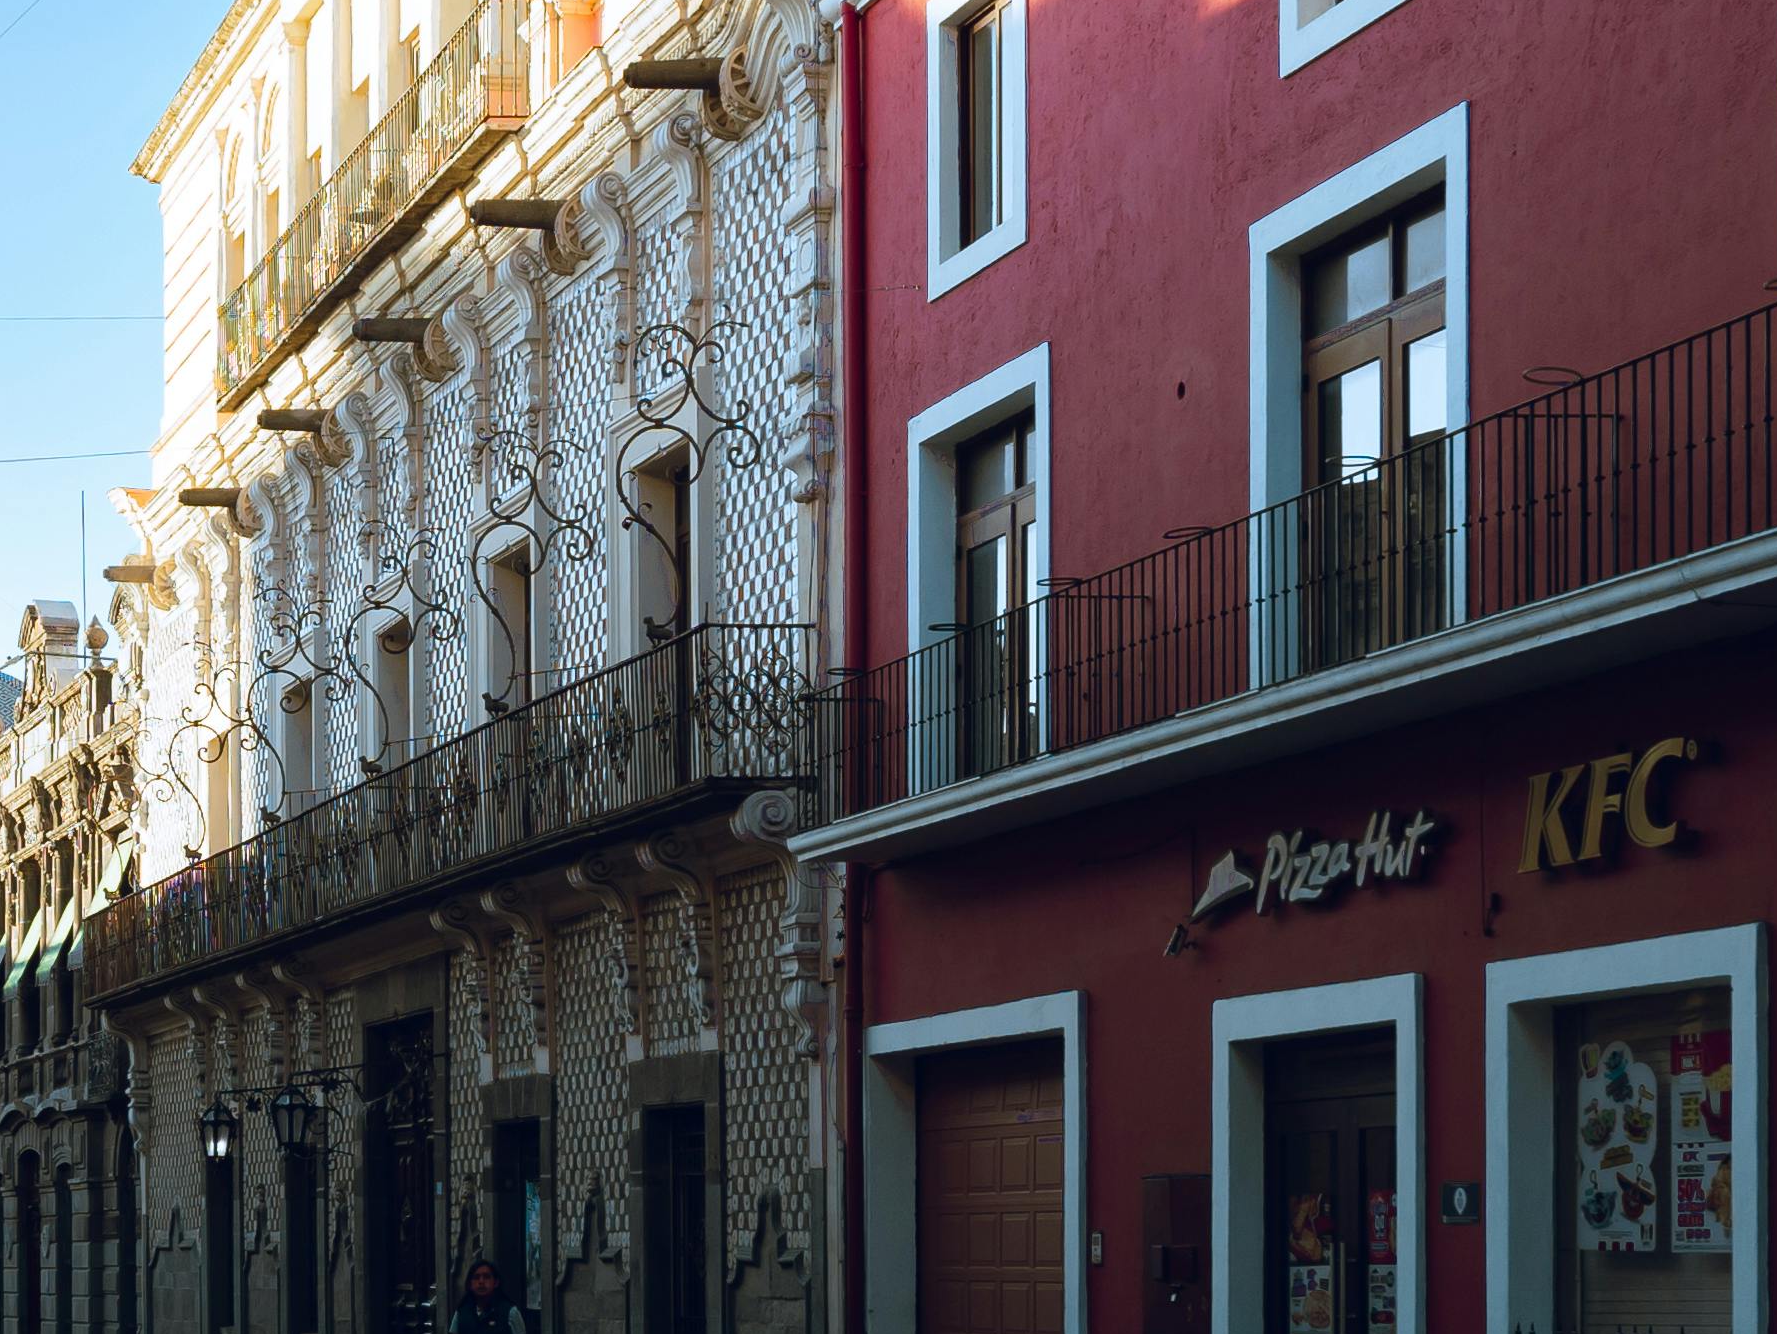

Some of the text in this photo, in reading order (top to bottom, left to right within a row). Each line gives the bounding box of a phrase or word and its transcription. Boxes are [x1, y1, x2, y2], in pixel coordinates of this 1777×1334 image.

[1254, 809, 1435, 917] Pizza Hut
[1516, 736, 1685, 875] KFC
